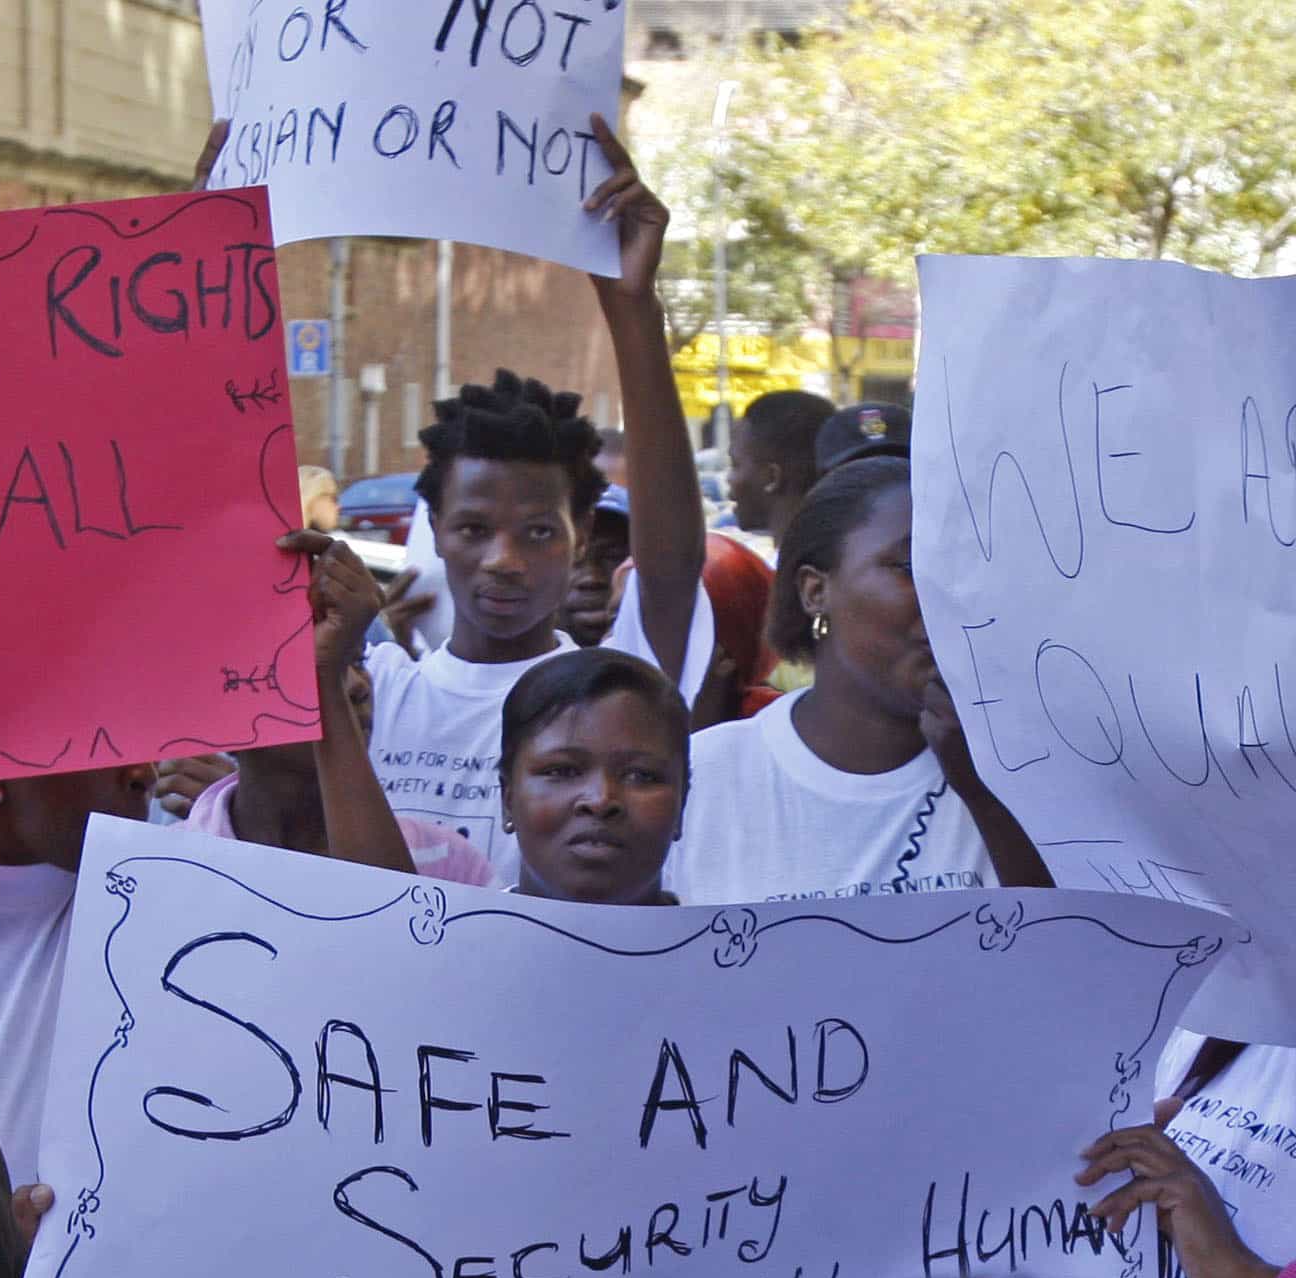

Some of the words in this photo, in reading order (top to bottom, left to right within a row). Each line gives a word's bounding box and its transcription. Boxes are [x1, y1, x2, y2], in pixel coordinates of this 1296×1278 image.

[435, 0, 592, 71] NOT
[374, 101, 462, 169] OR
[497, 111, 597, 200] NOT
[47, 243, 277, 358] RIGHTS
[944, 356, 1196, 579] WE
[415, 751, 448, 768] FOR
[452, 783, 501, 800] DIGNIT
[142, 931, 571, 1148] SAFE
[639, 1017, 870, 1150] AND
